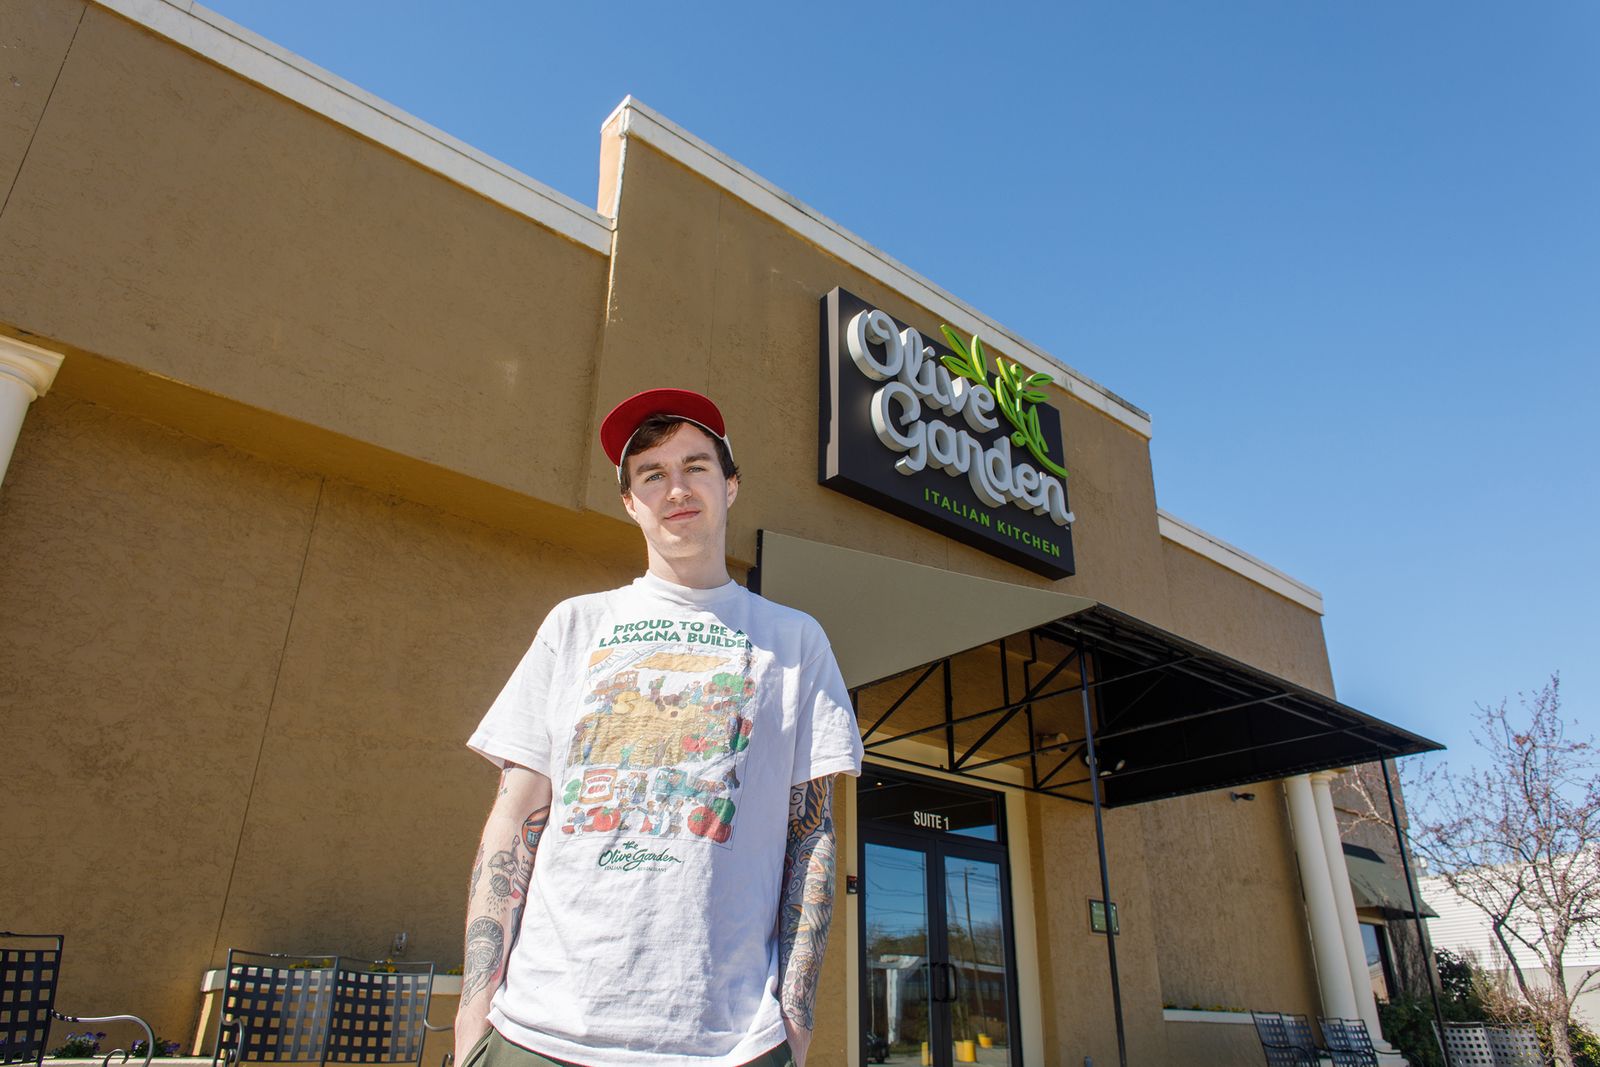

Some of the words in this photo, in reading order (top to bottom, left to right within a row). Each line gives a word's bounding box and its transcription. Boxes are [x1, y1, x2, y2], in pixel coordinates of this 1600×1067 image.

[847, 309, 999, 433] Olive
[871, 381, 1075, 526] Garden
[924, 488, 990, 527] ITALIAN
[997, 520, 1060, 557] KITCHEN
[613, 619, 674, 635] PROUD
[679, 621, 705, 632] TO
[709, 624, 728, 636] BE
[599, 629, 681, 648] LASAGNA
[687, 632, 753, 652] BUILDER
[913, 810, 942, 829] SUITE
[943, 816, 949, 830] 1
[622, 841, 639, 850] the
[598, 849, 632, 867] Olive
[623, 847, 682, 872] Garden
